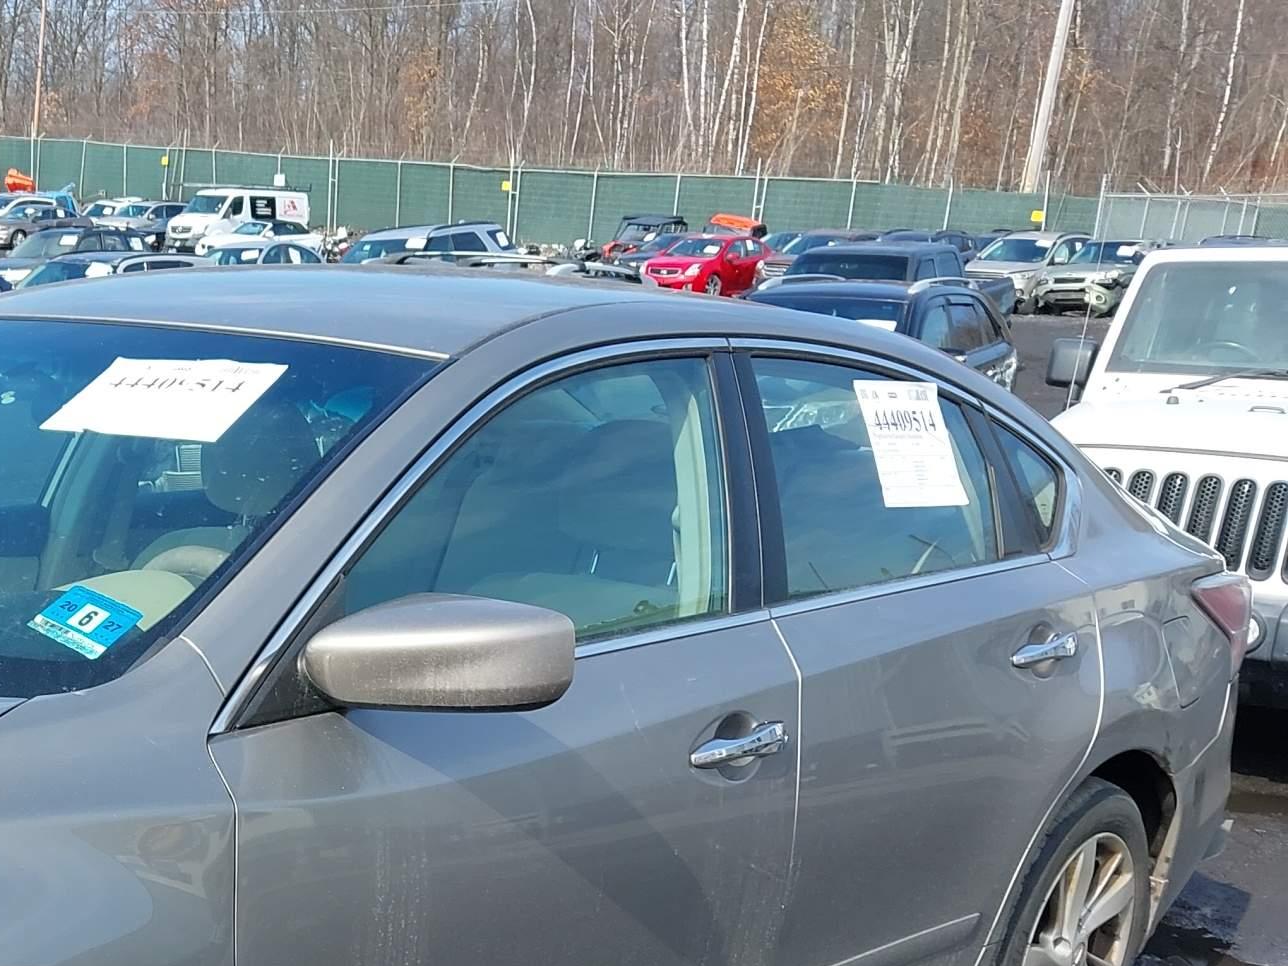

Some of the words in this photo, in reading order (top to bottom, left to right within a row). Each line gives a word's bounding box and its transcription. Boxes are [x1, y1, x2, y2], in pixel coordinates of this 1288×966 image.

[874, 408, 937, 432] 44409514
[59, 600, 78, 613] 20
[78, 610, 99, 627] 6
[102, 619, 123, 633] 27
